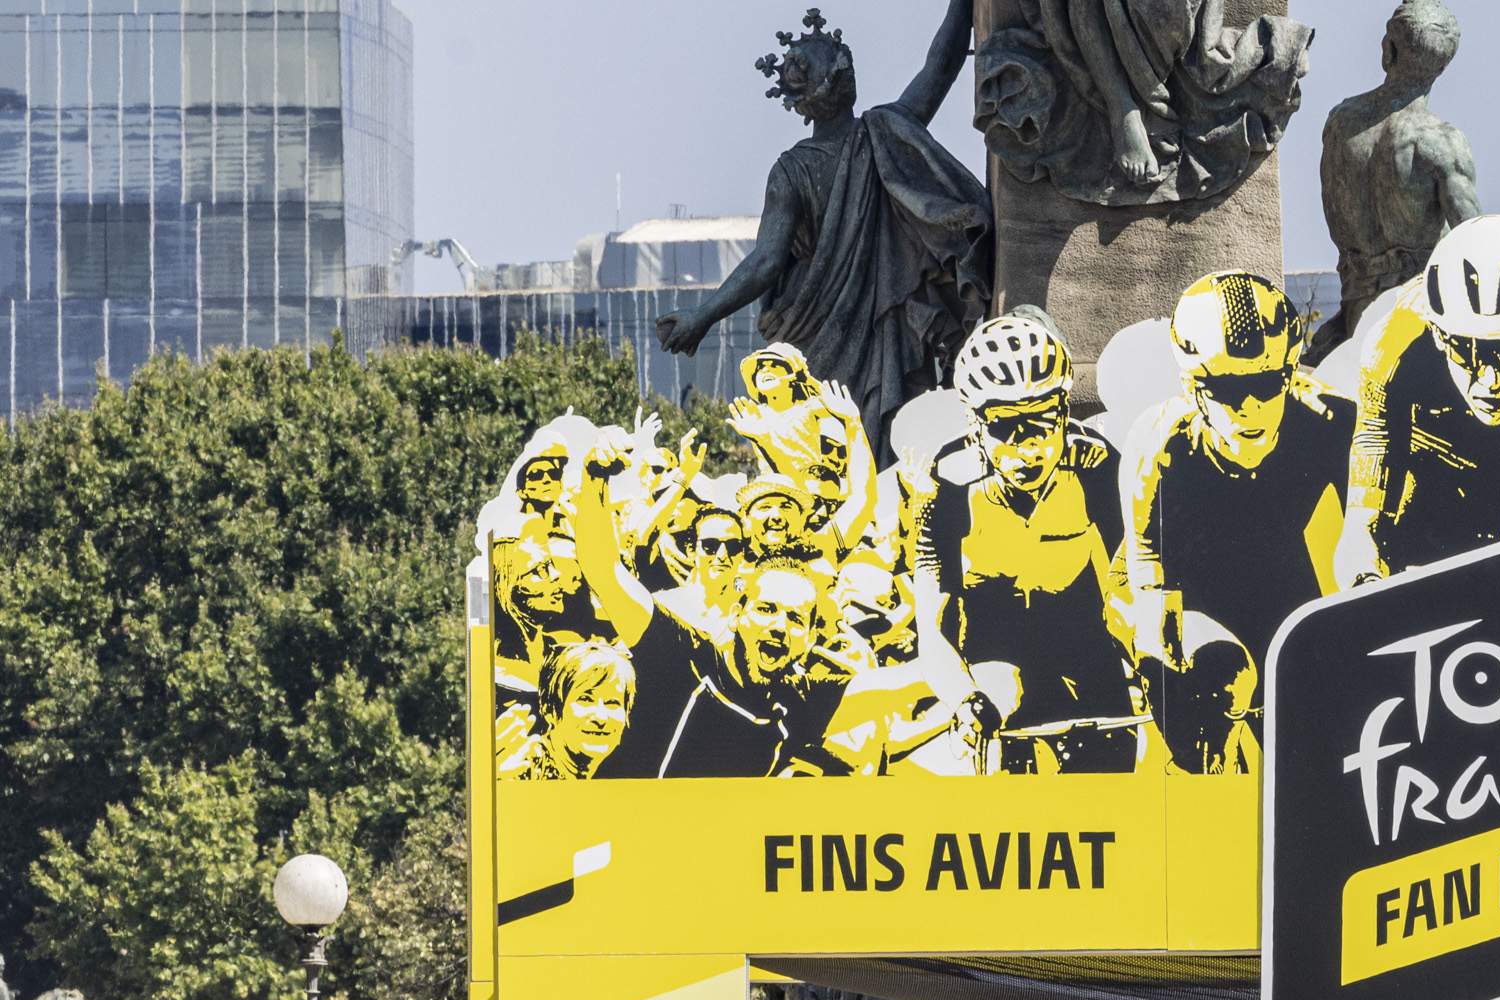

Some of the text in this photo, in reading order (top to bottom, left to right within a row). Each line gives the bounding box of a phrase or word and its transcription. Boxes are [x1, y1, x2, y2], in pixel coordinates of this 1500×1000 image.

[765, 831, 1116, 892] FINS AVIAT
[1376, 863, 1481, 947] FAN
